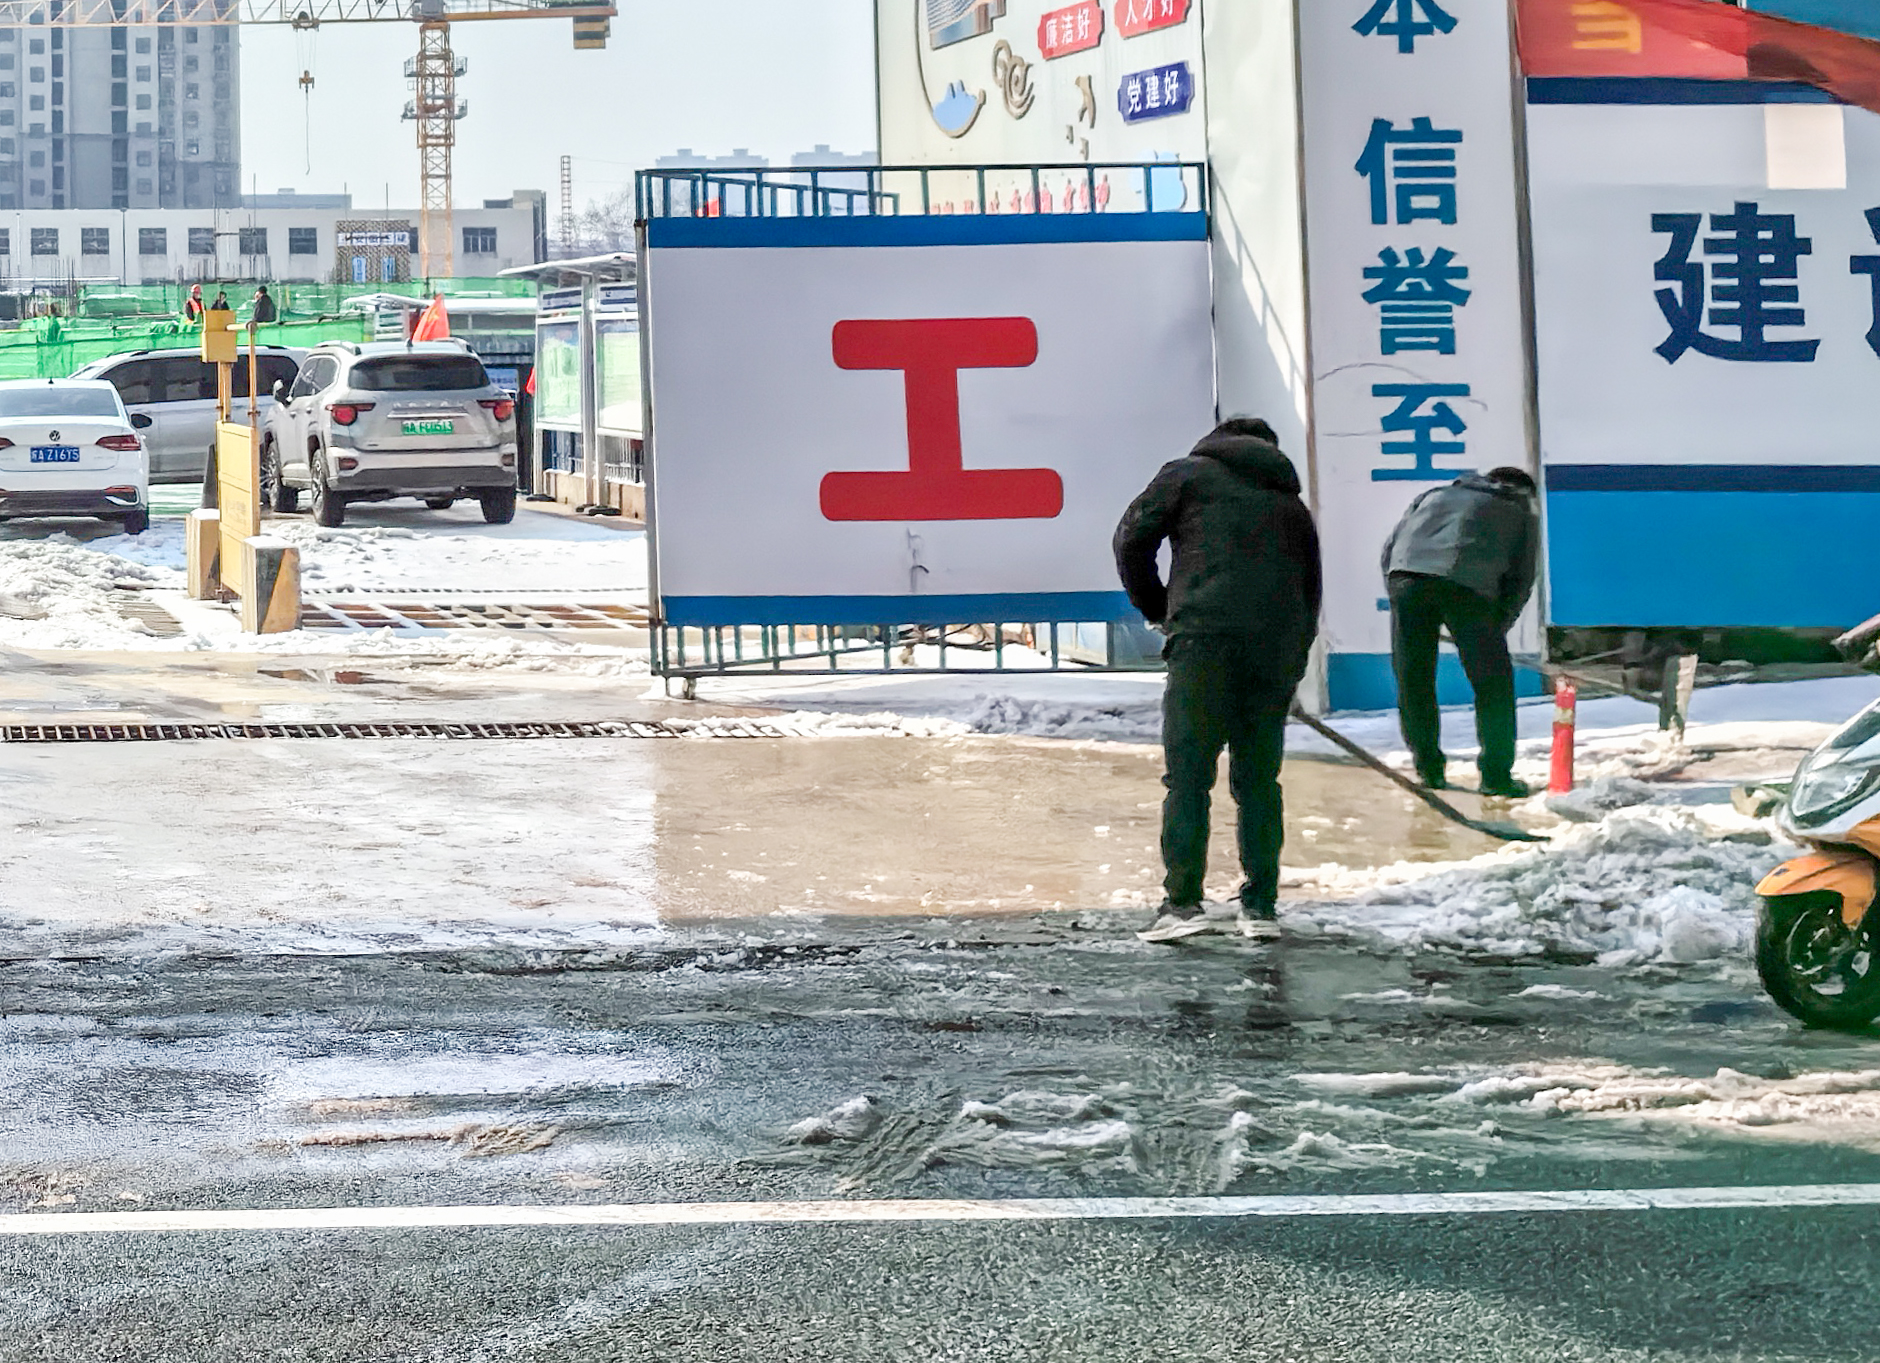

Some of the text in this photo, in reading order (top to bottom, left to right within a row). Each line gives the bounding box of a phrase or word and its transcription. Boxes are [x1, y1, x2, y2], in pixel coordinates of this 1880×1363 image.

[1127, 70, 1179, 114] 党建好
[819, 316, 1063, 522] 工
[1355, 117, 1470, 612] 信誉至
